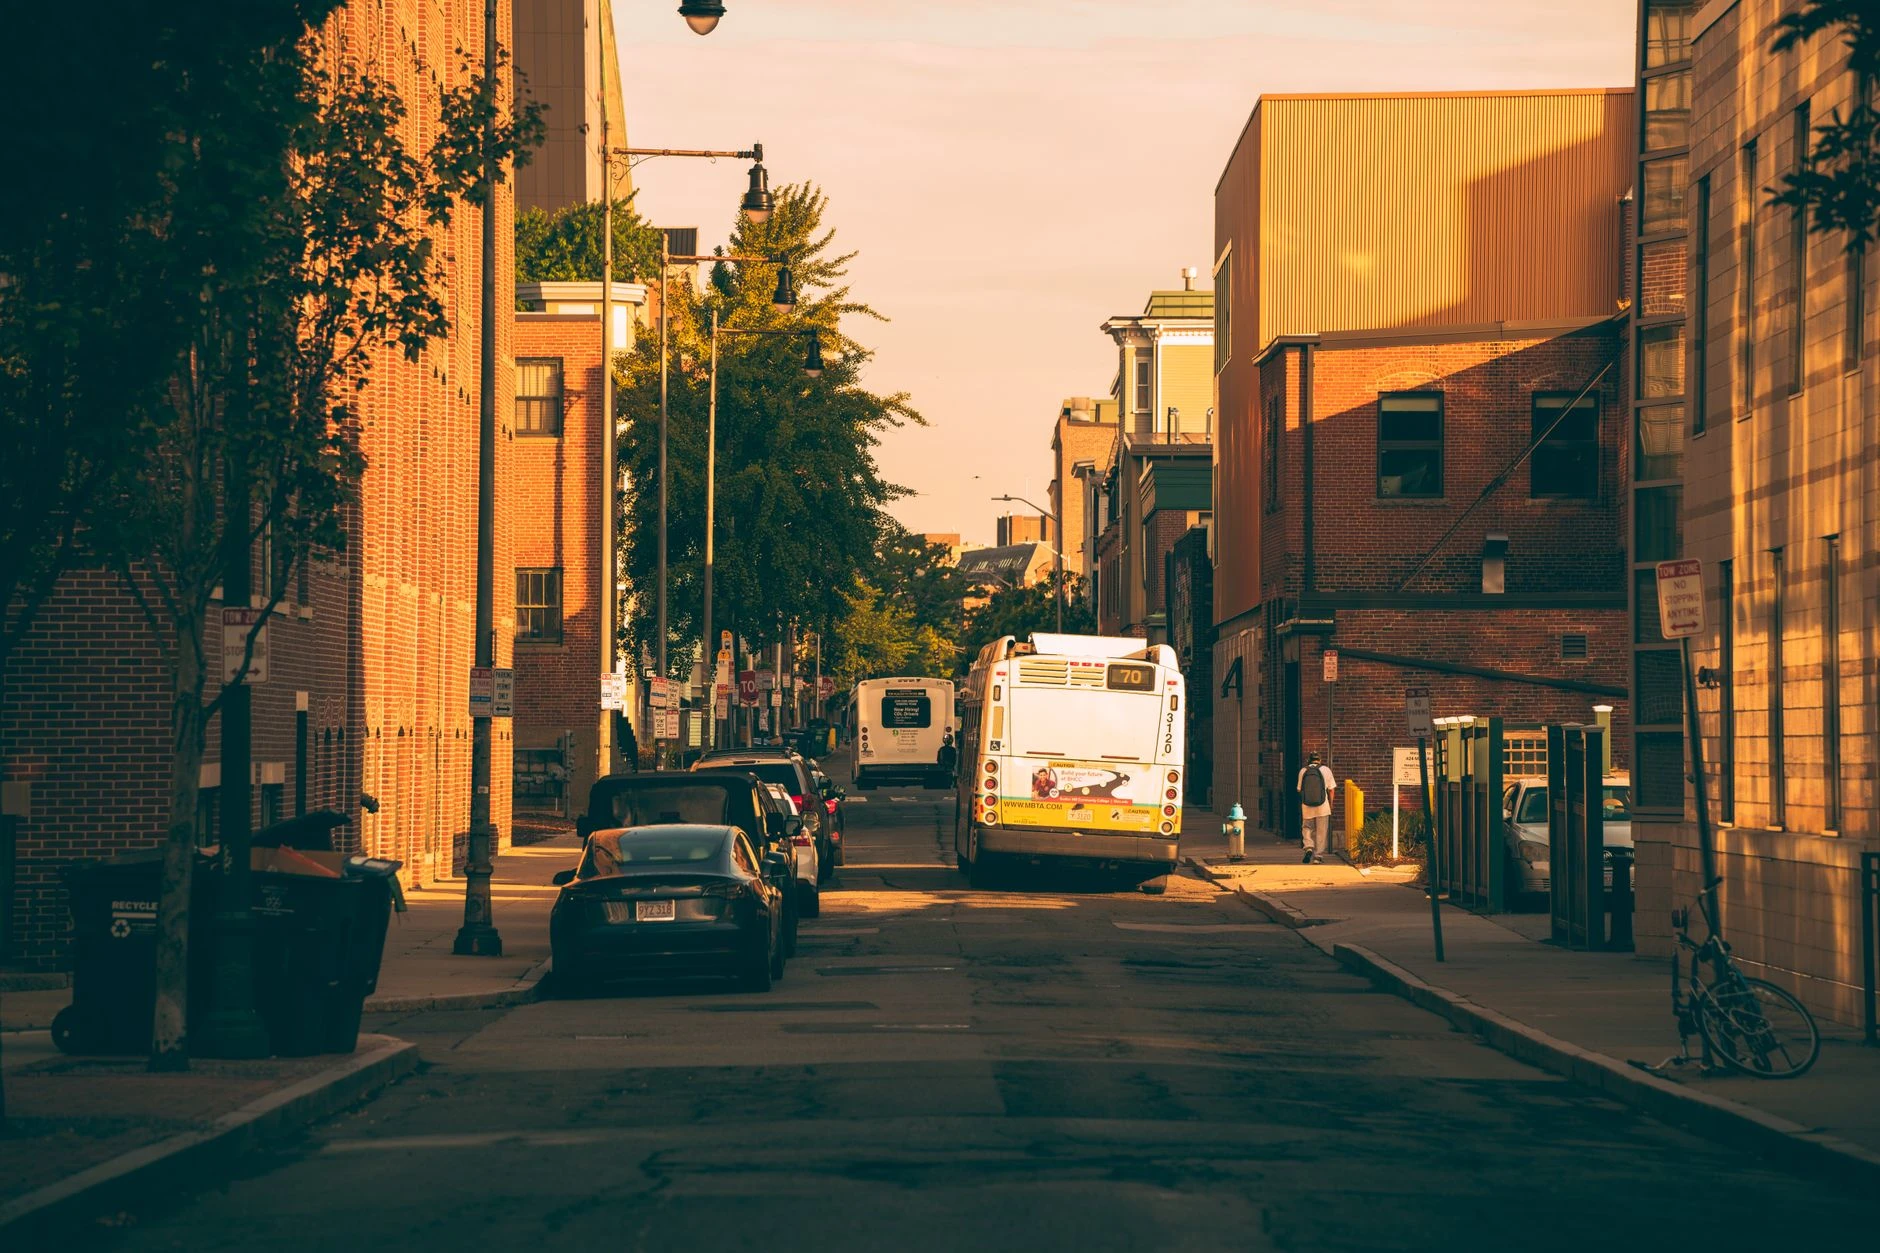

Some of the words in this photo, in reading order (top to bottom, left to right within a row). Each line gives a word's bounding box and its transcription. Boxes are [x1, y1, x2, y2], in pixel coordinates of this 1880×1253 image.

[1660, 566, 1675, 577] TOW
[1680, 563, 1700, 575] ZONE
[1674, 580, 1686, 589] NO
[1664, 592, 1700, 605] STOPPING
[225, 611, 242, 624] TOW
[1667, 607, 1699, 619] ANYTIME
[1120, 669, 1142, 684] 70
[1164, 712, 1174, 754] 3120
[1003, 801, 1063, 810] WWW.MBTA.COM
[111, 900, 159, 911] RECYCLE
